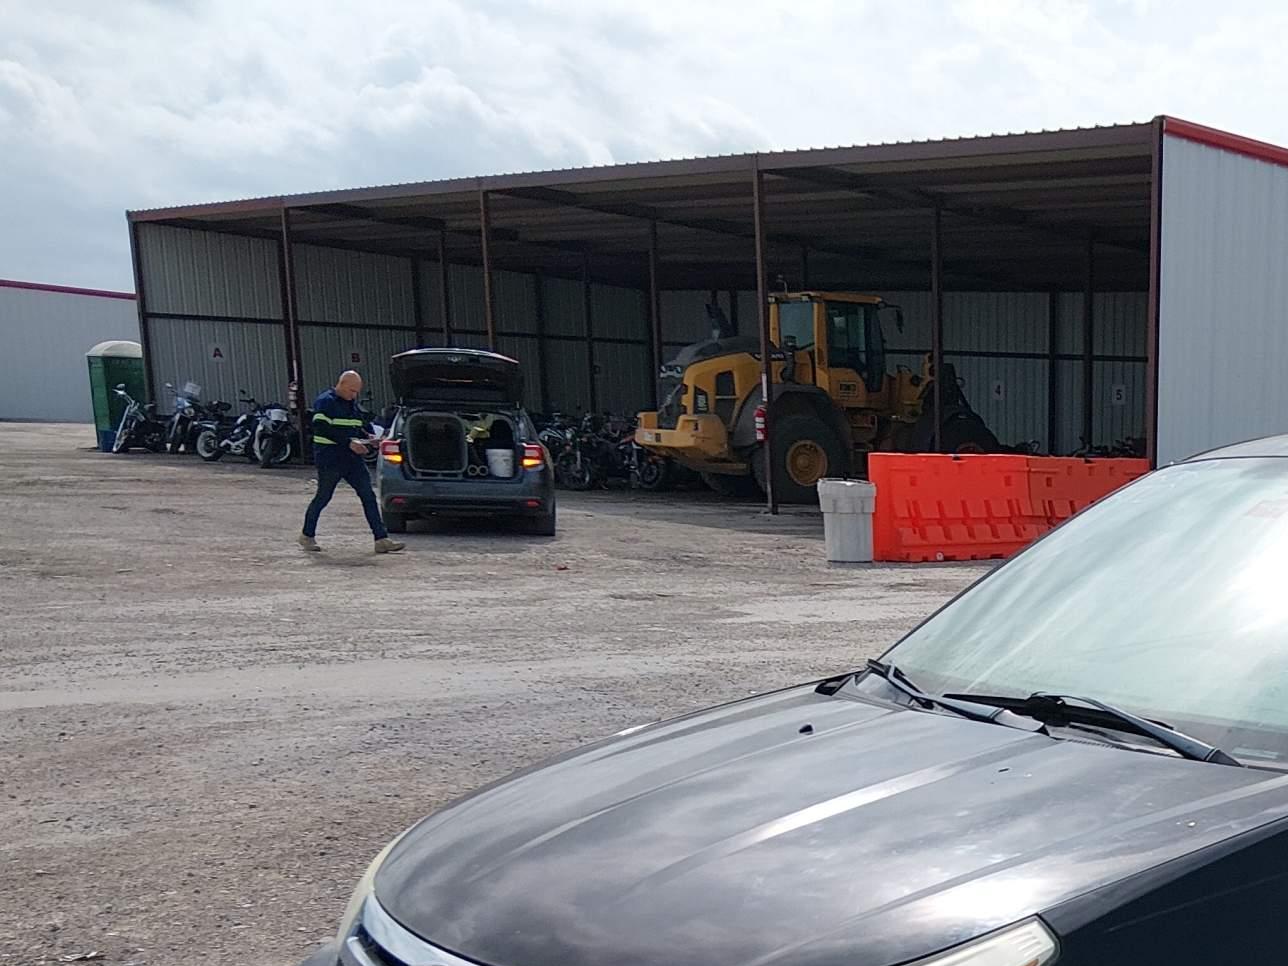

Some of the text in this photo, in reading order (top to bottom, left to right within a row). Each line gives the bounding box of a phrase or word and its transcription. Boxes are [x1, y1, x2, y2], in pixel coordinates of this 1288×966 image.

[213, 347, 223, 358] A
[351, 353, 360, 362] B
[994, 384, 1001, 395] 4
[1116, 389, 1123, 400] 5
